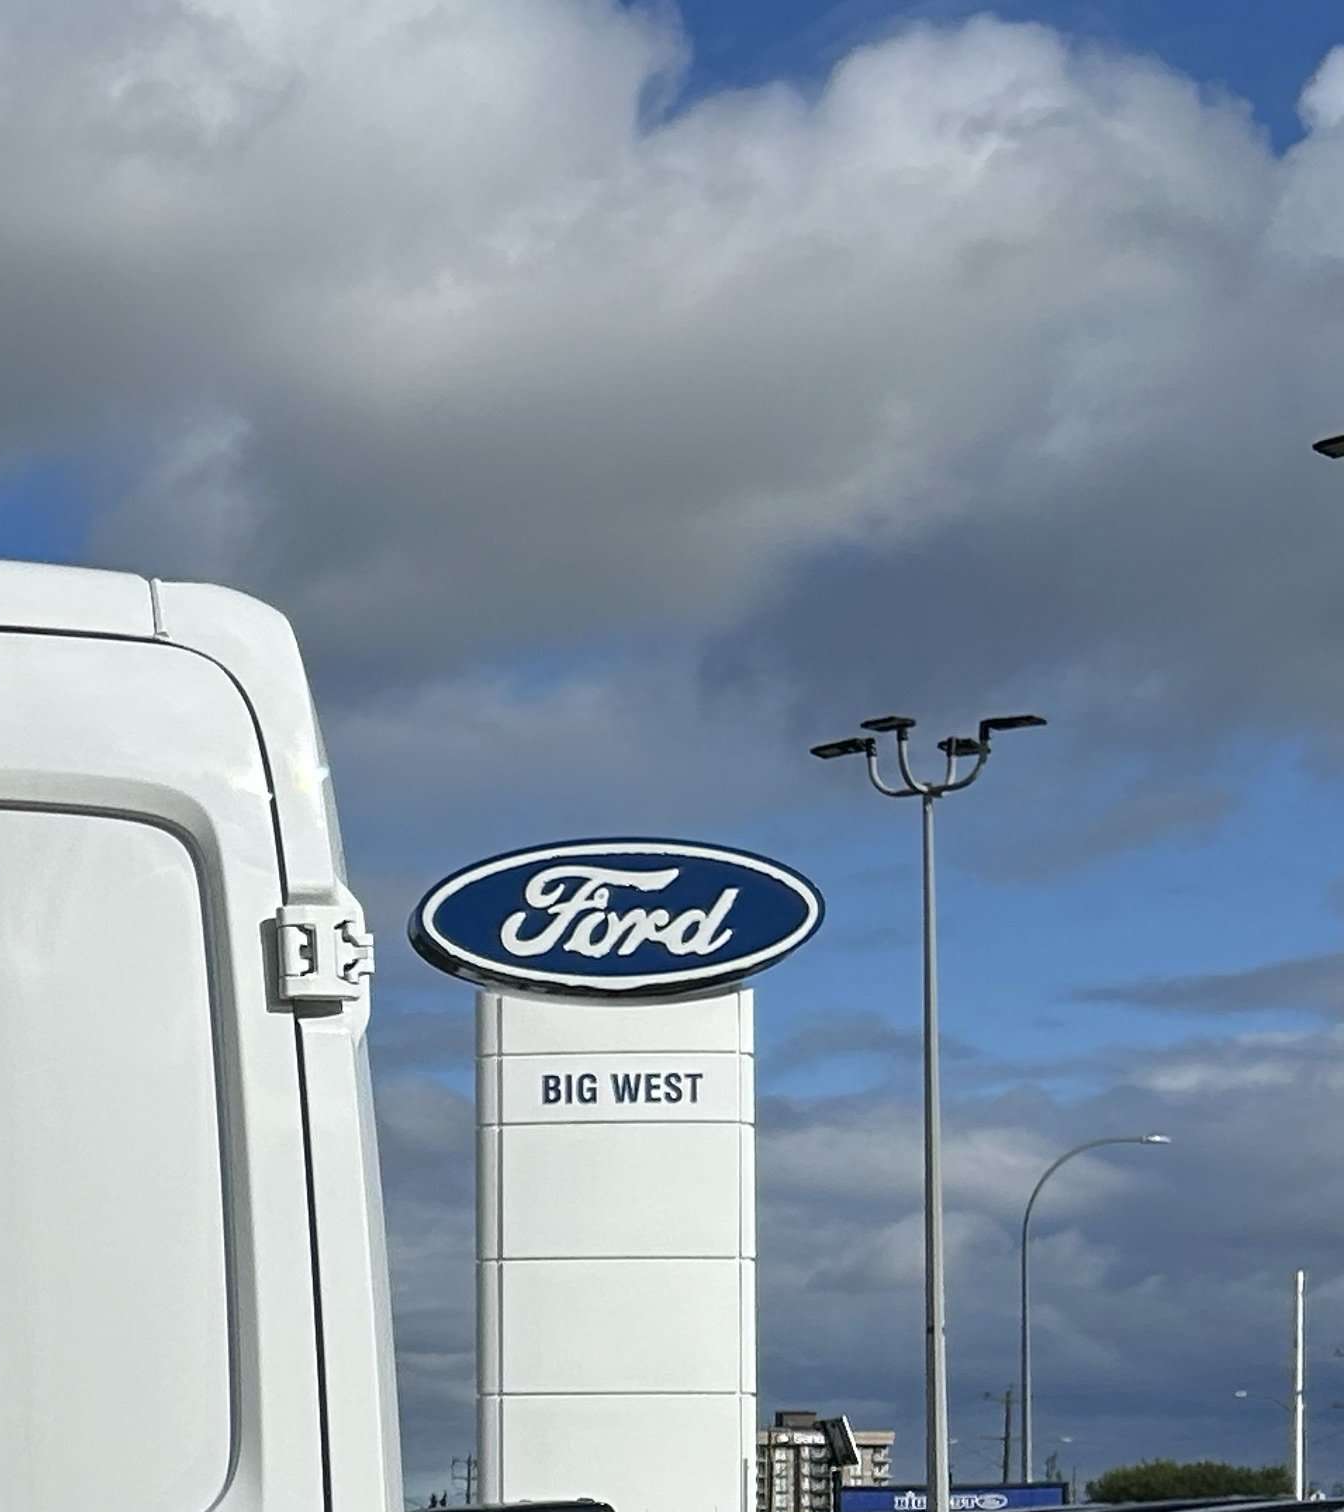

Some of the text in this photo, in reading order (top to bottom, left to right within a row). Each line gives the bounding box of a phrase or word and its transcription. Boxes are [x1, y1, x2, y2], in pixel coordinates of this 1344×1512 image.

[501, 864, 740, 959] Ford
[541, 1072, 704, 1105] BIG WEST
